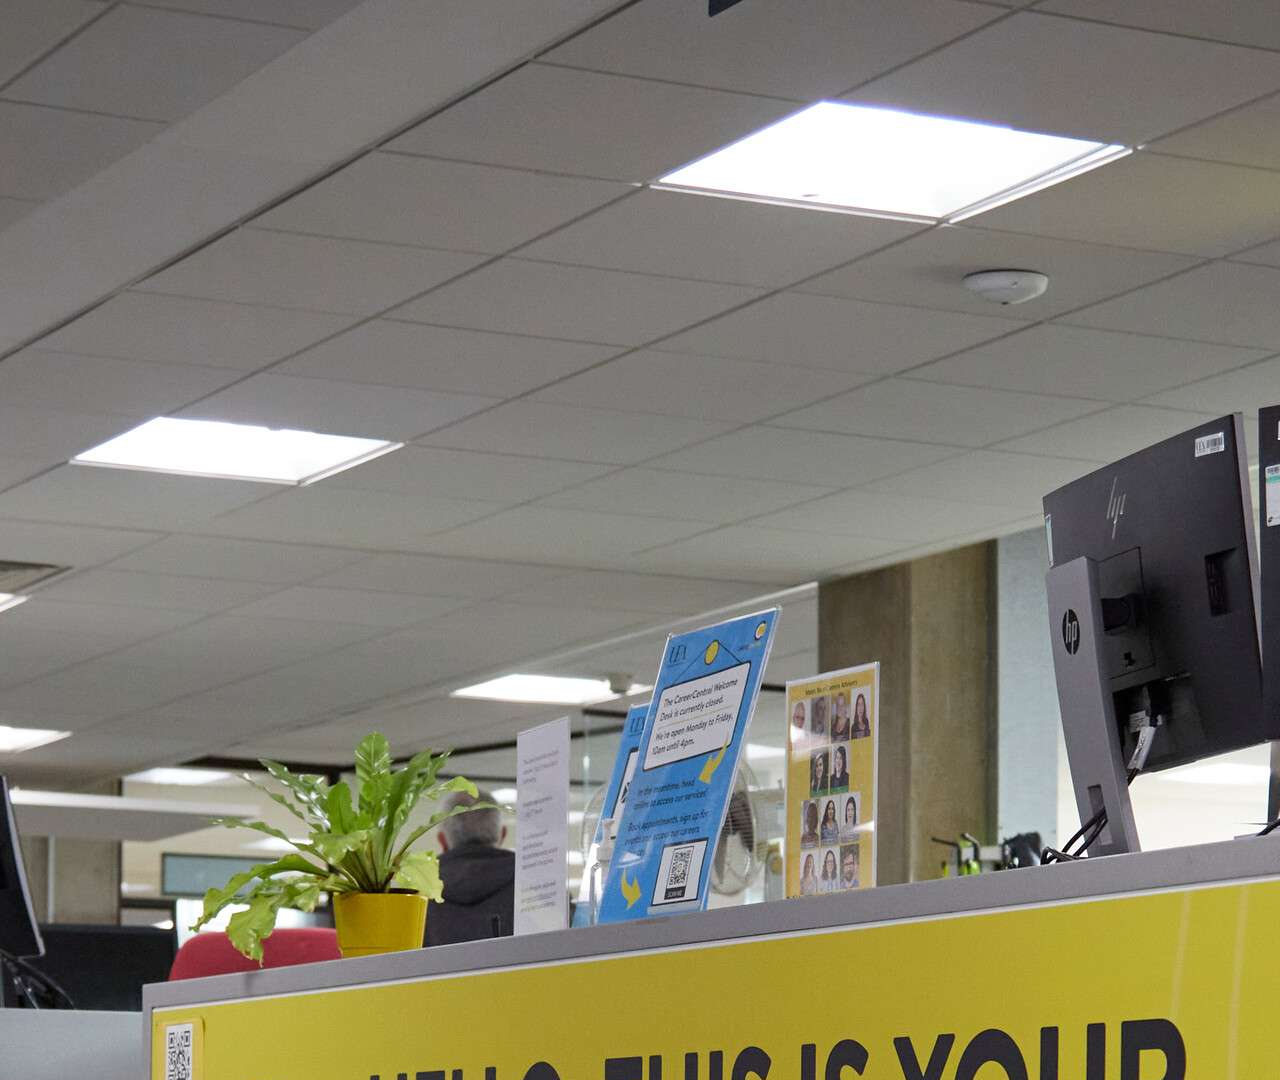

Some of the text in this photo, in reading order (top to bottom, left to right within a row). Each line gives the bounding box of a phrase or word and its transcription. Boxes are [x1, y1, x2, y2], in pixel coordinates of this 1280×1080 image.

[1064, 609, 1080, 655] hp
[663, 679, 738, 707] The CareerCentral Welcome
[659, 710, 673, 722] Desk
[679, 702, 705, 716] currently
[671, 728, 685, 738] open
[686, 720, 707, 732] Monday
[666, 740, 680, 751] until
